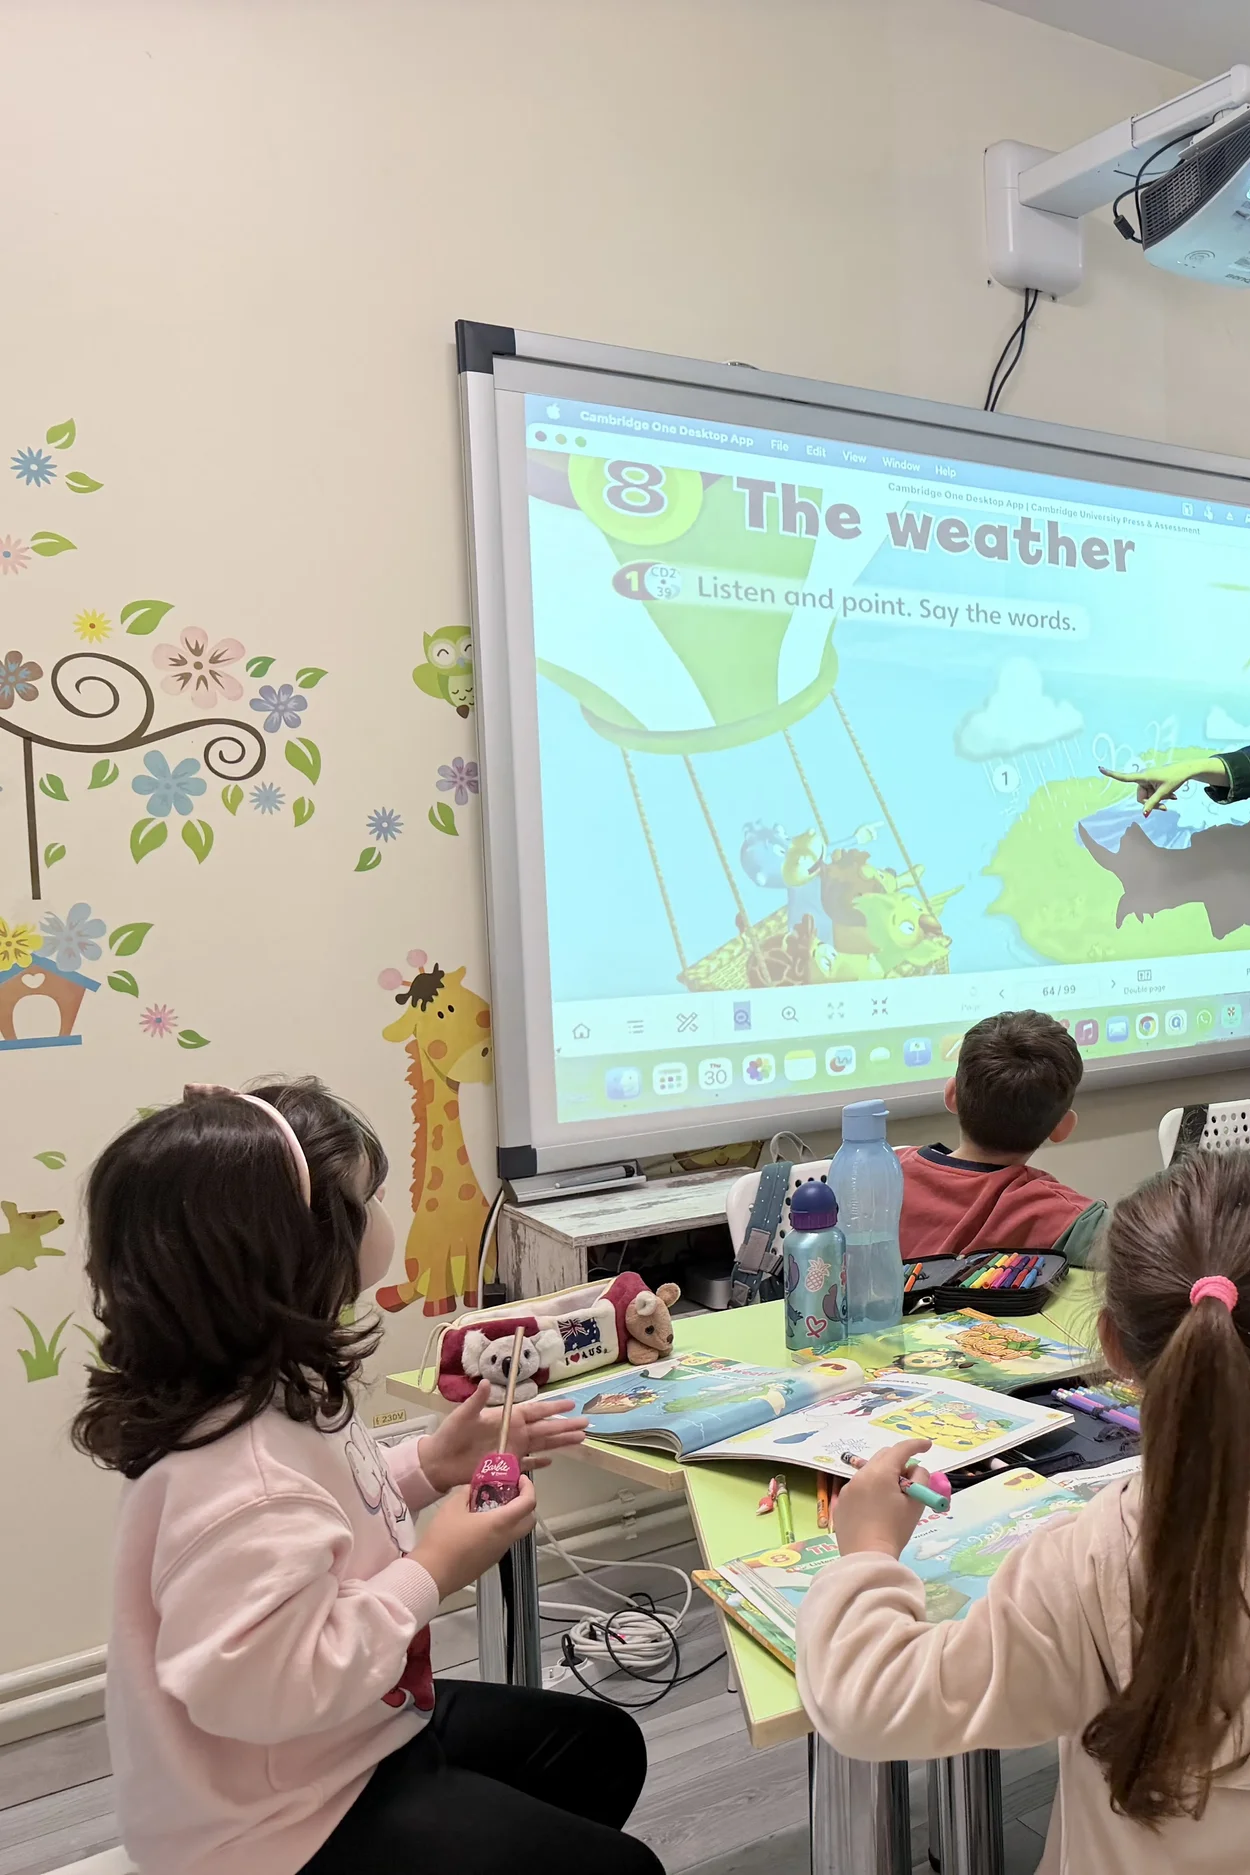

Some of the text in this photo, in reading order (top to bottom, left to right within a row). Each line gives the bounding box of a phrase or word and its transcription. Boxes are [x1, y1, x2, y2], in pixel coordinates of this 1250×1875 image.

[580, 410, 957, 478] Cambridge One Desktop App File Edit View Window Help
[604, 459, 667, 516] 8
[888, 482, 942, 499] Cambridge
[944, 490, 964, 501] One
[966, 494, 1004, 507] Desktop
[1006, 500, 1024, 510] App
[1031, 503, 1078, 518] Cambridge
[1080, 510, 1121, 525] University
[1123, 517, 1145, 527] Press
[1154, 521, 1201, 536] Assessment
[734, 476, 1136, 573] The weather
[651, 566, 677, 579] CD2
[625, 570, 639, 592] 1
[656, 586, 672, 598] 39
[698, 576, 1076, 632] Listen and point. Say the words.
[1001, 771, 1010, 786] 1
[1123, 985, 1166, 995] Double page
[704, 1069, 727, 1085] 30
[382, 1411, 404, 1423] 230V
[481, 1459, 510, 1473] Barbie
